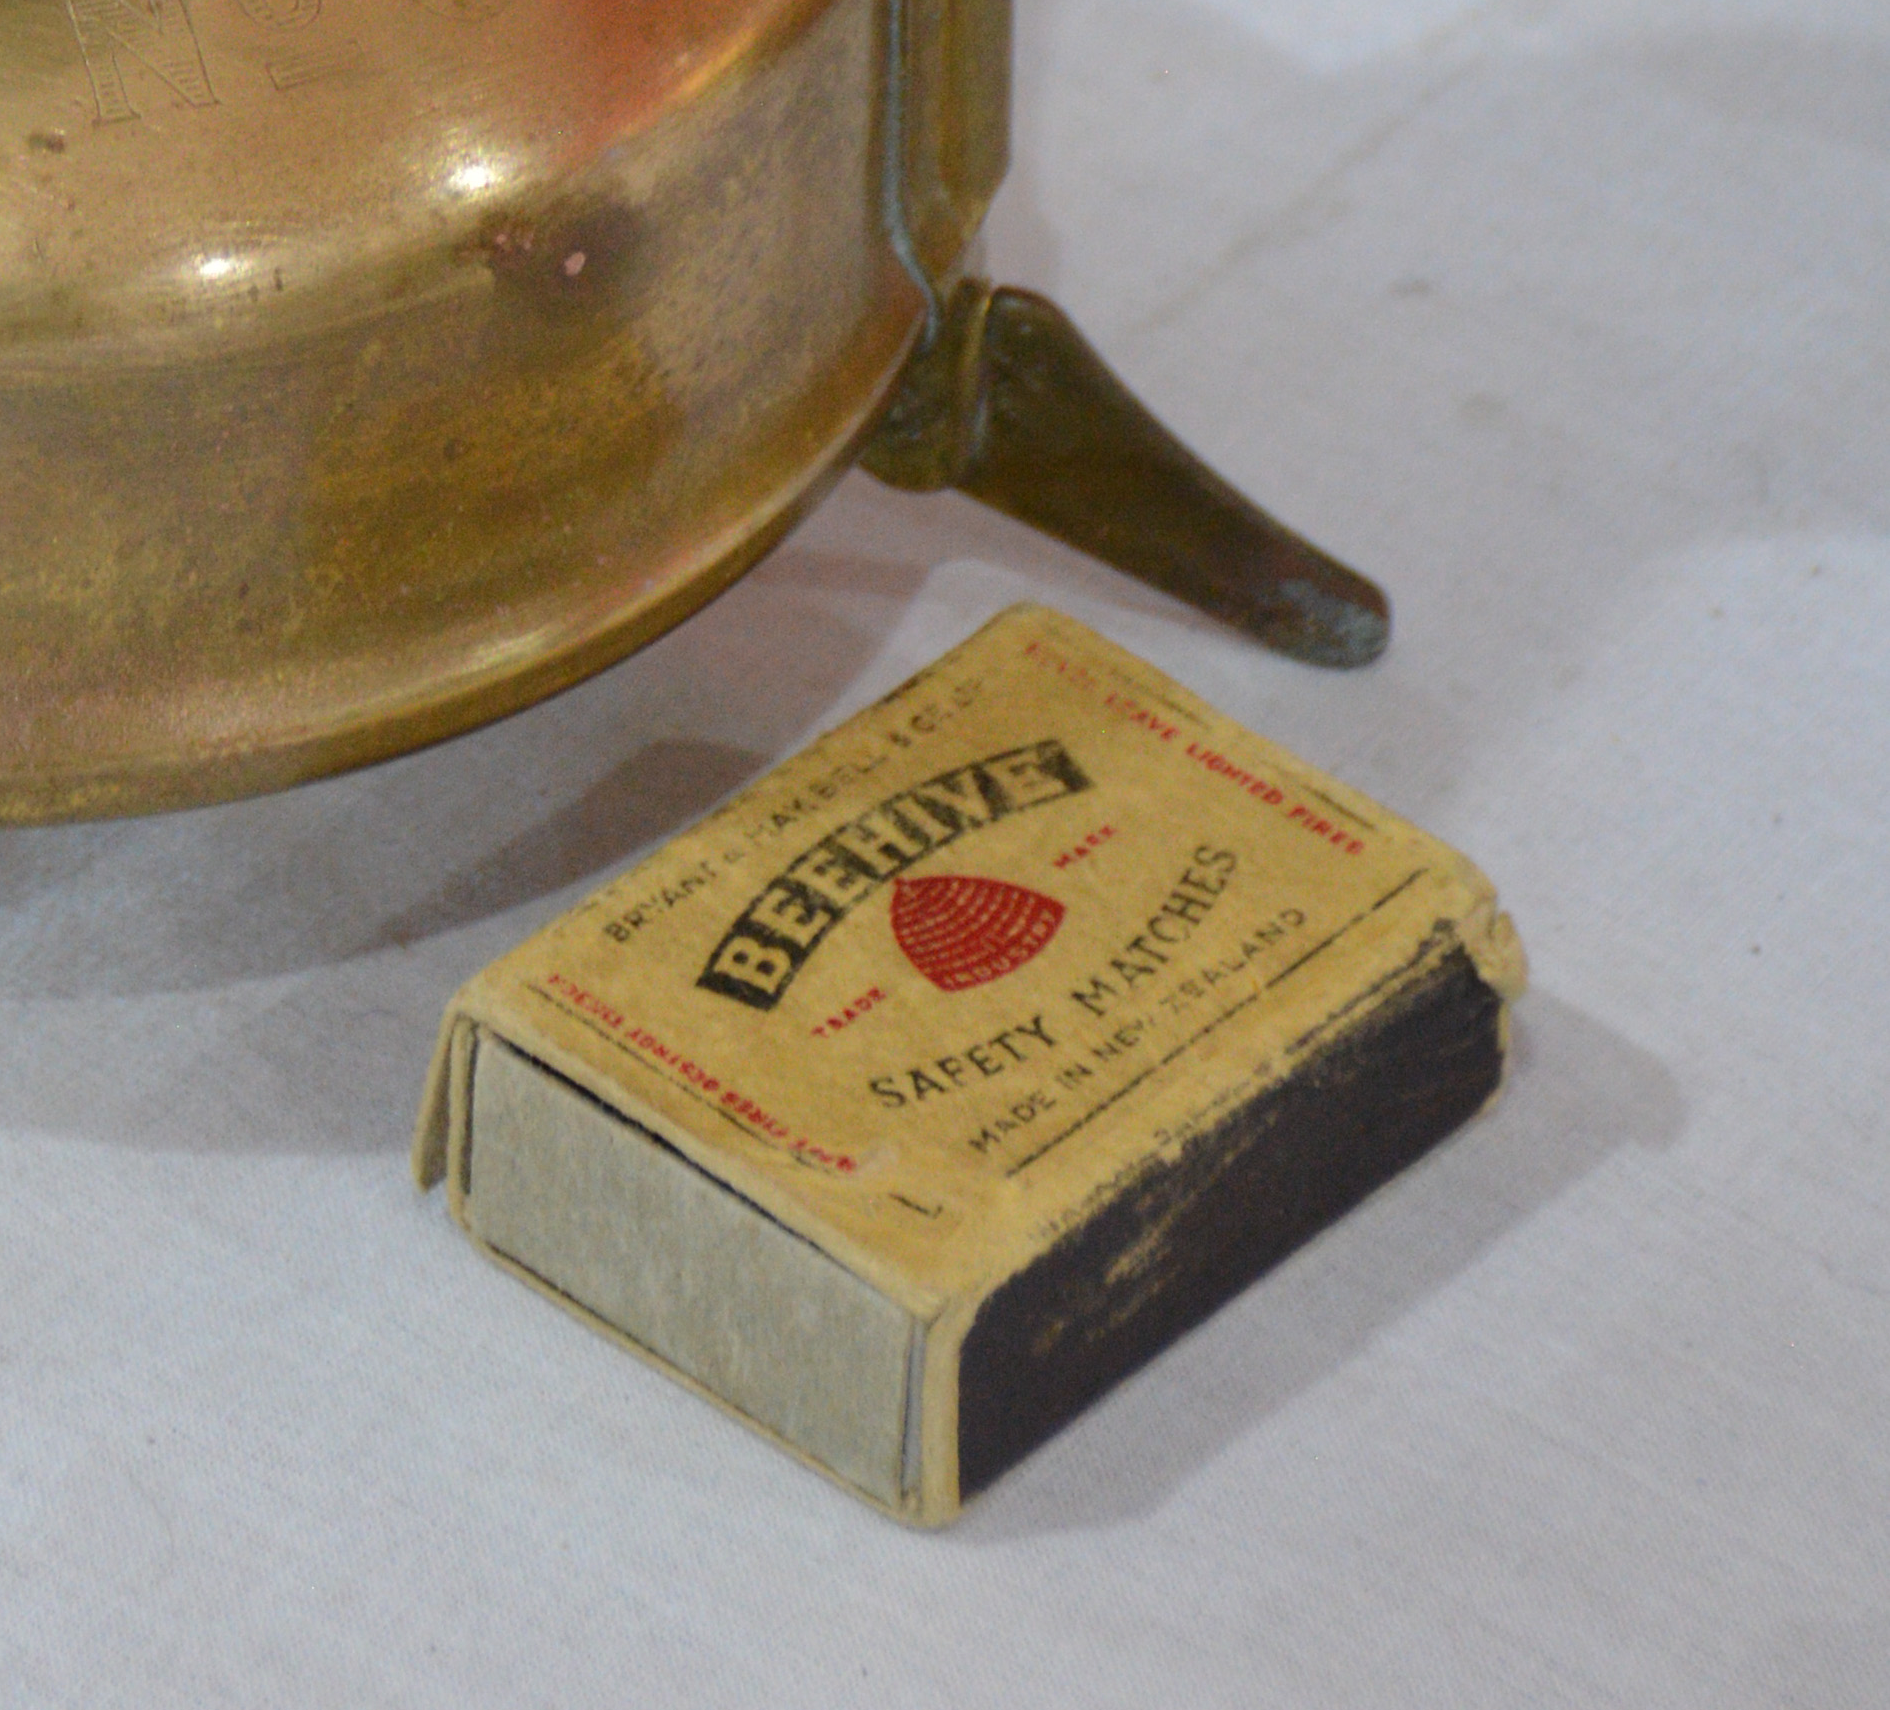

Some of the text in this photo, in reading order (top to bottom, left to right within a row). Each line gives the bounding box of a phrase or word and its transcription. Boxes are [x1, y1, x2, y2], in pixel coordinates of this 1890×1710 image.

[702, 741, 1082, 1007] BEEHIVE
[1184, 741, 1284, 807] LIGHTED
[811, 824, 1119, 1039] TRADE MARK
[867, 843, 1239, 1111] SAFETY MATCHES
[967, 1086, 1058, 1156] MADE
[1052, 1062, 1093, 1094] IN
[1159, 905, 1309, 1018] ZEALAND
